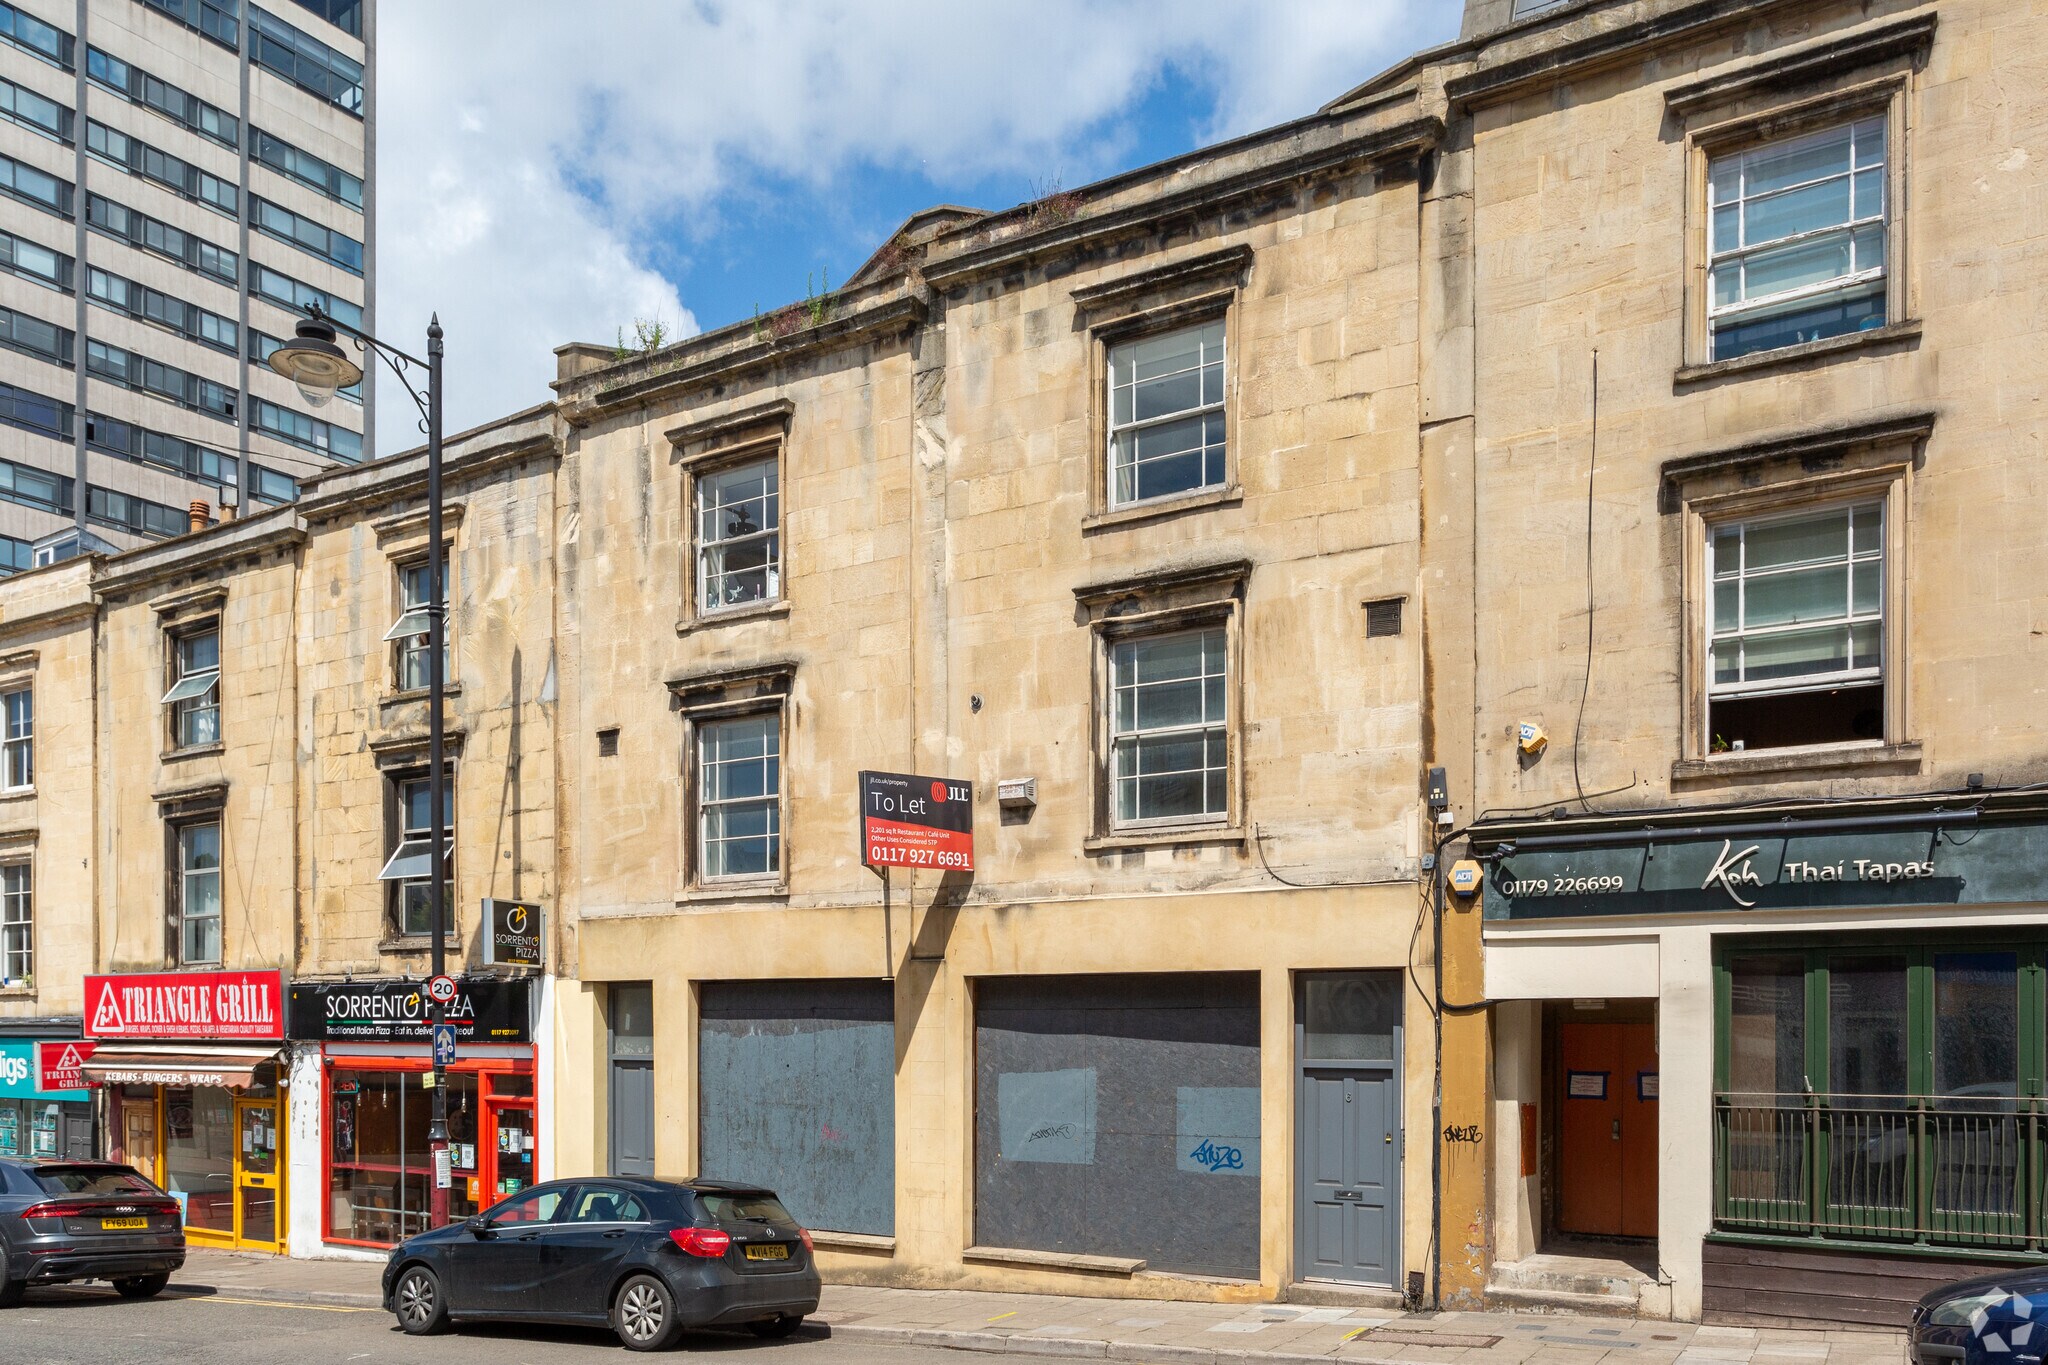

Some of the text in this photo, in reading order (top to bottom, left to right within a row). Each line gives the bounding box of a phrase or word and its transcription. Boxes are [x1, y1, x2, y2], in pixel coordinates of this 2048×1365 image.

[948, 786, 968, 801] JLL
[871, 791, 926, 815] To Let
[900, 837, 927, 845] Considered
[872, 846, 969, 867] 0117 927 6691
[1455, 870, 1473, 882] ADT
[1853, 859, 1935, 884] Tapas
[1502, 876, 1624, 895] 01179 226699
[495, 933, 540, 947] SORRENTO
[516, 947, 539, 959] PIZZA
[433, 983, 453, 995] 20
[122, 982, 273, 1024] TRIANGLE GRILL
[326, 993, 420, 1018] SORRENTO
[327, 1026, 356, 1035] Traditional
[357, 1026, 374, 1035] Italian
[375, 1026, 390, 1035] Pizza
[395, 1026, 405, 1035] Eat
[105, 1071, 138, 1082] KEBABS
[142, 1072, 183, 1083] BURGERS
[189, 1074, 222, 1084] WRAPS
[105, 1218, 127, 1228] FY69
